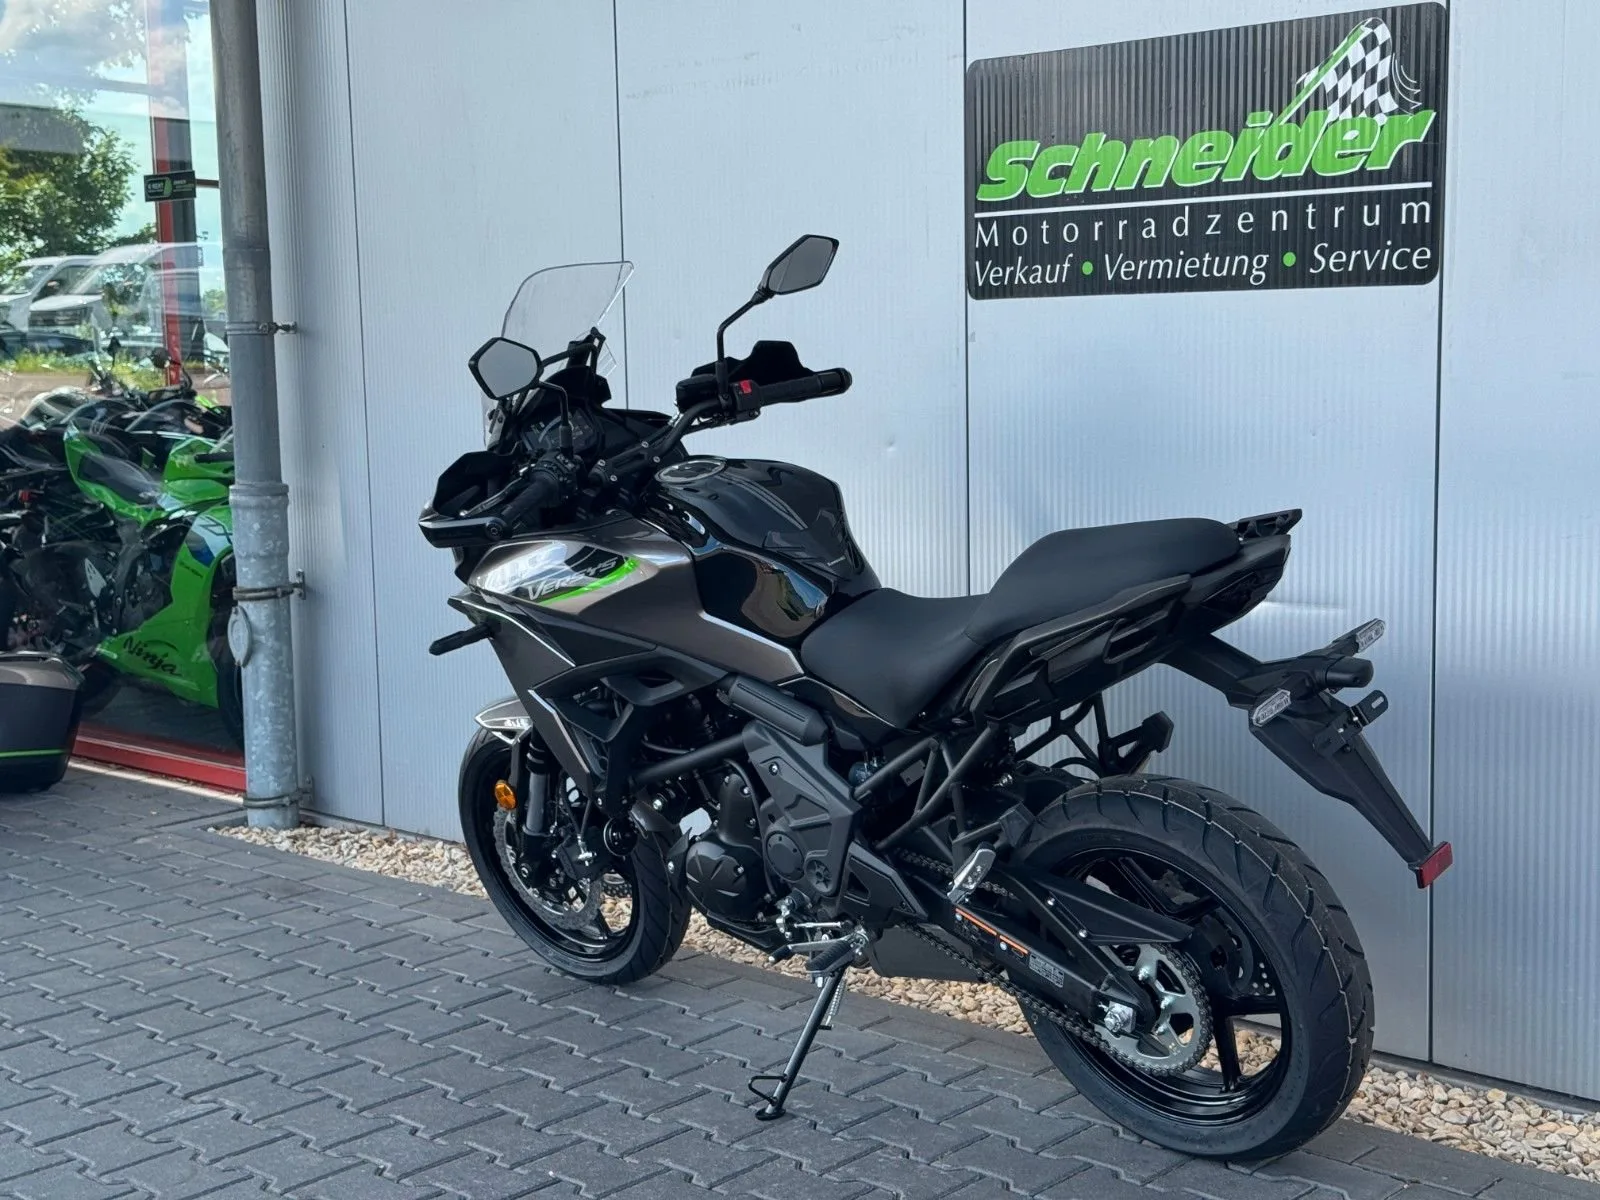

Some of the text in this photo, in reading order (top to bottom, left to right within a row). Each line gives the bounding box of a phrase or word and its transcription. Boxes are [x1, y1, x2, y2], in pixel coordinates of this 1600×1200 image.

[974, 201, 1431, 248] Motorradzentrum
[974, 241, 1432, 287] Verkauf Vermietung Service
[122, 635, 183, 676] Ninja
